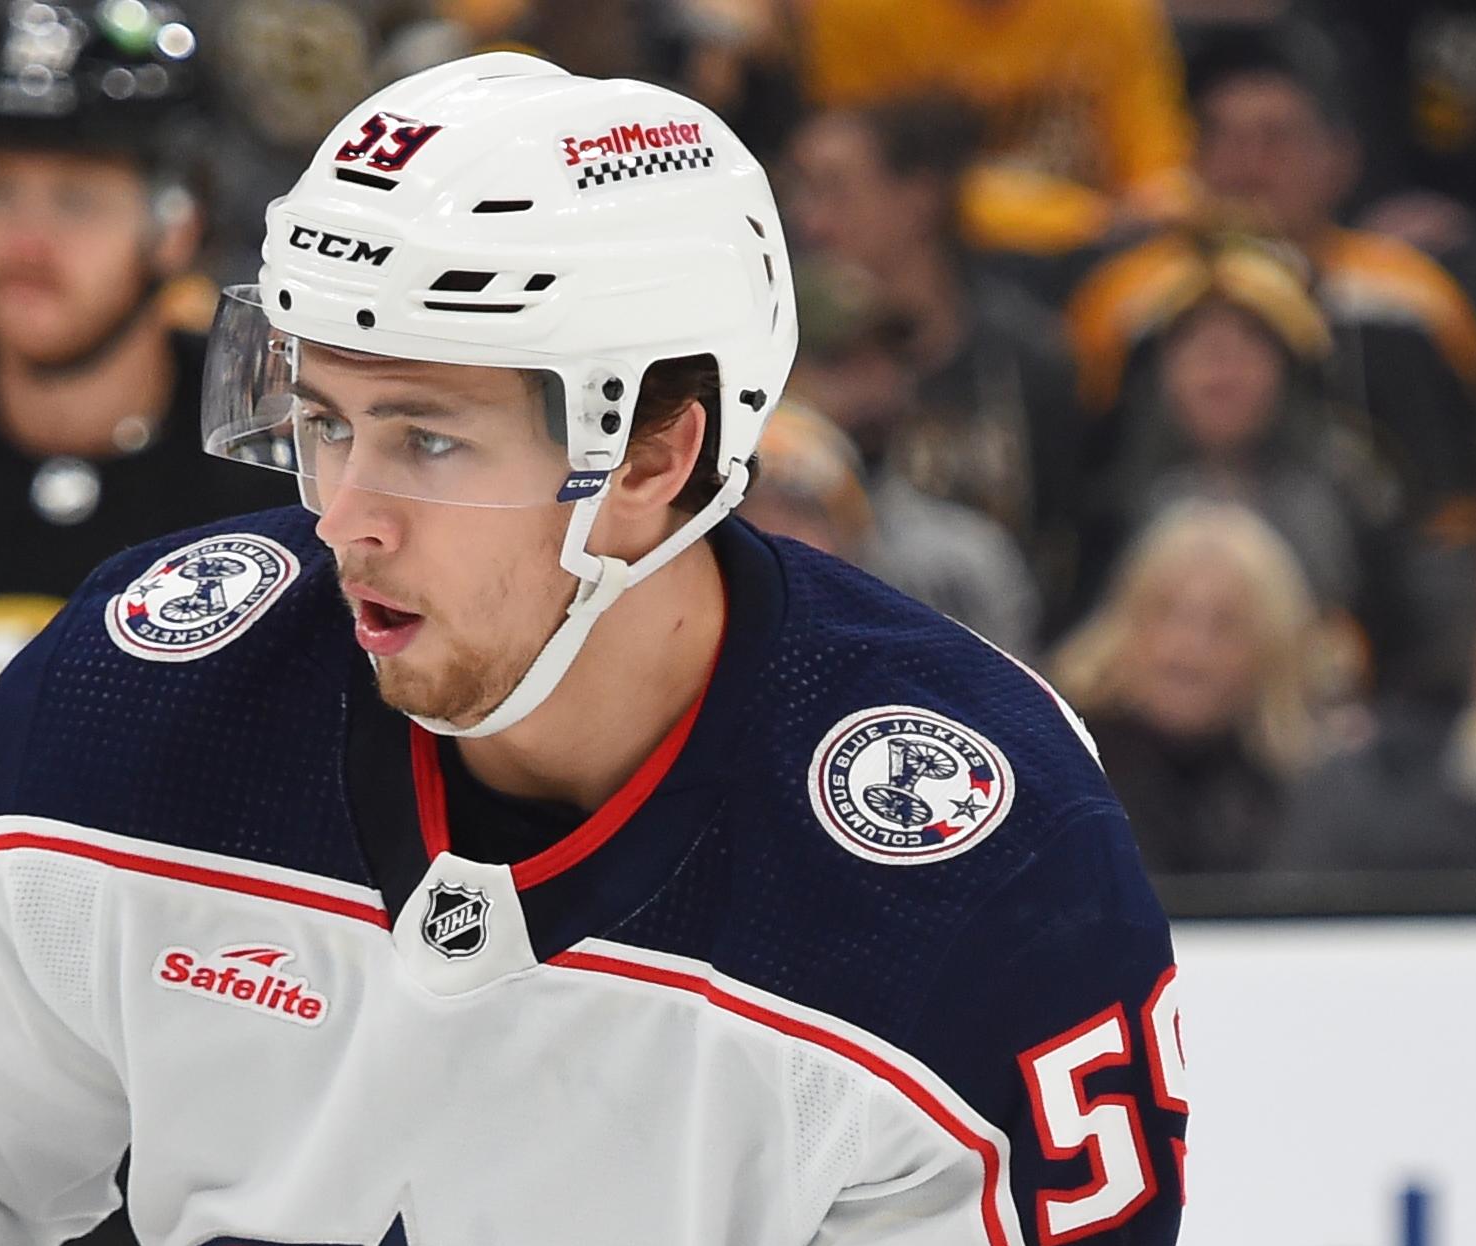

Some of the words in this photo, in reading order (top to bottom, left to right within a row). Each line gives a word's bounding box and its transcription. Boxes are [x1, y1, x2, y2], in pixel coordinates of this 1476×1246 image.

[288, 225, 395, 266] CCM
[566, 478, 604, 489] CCM
[186, 542, 278, 577] COLUMBUS
[233, 576, 274, 615] BLUE
[137, 614, 230, 643] JACKETS
[834, 726, 883, 769] BLUE
[888, 720, 985, 767] JACKETS
[832, 772, 923, 846] COLUMBUS
[433, 904, 479, 940] NHL
[160, 952, 322, 1019] Safelite
